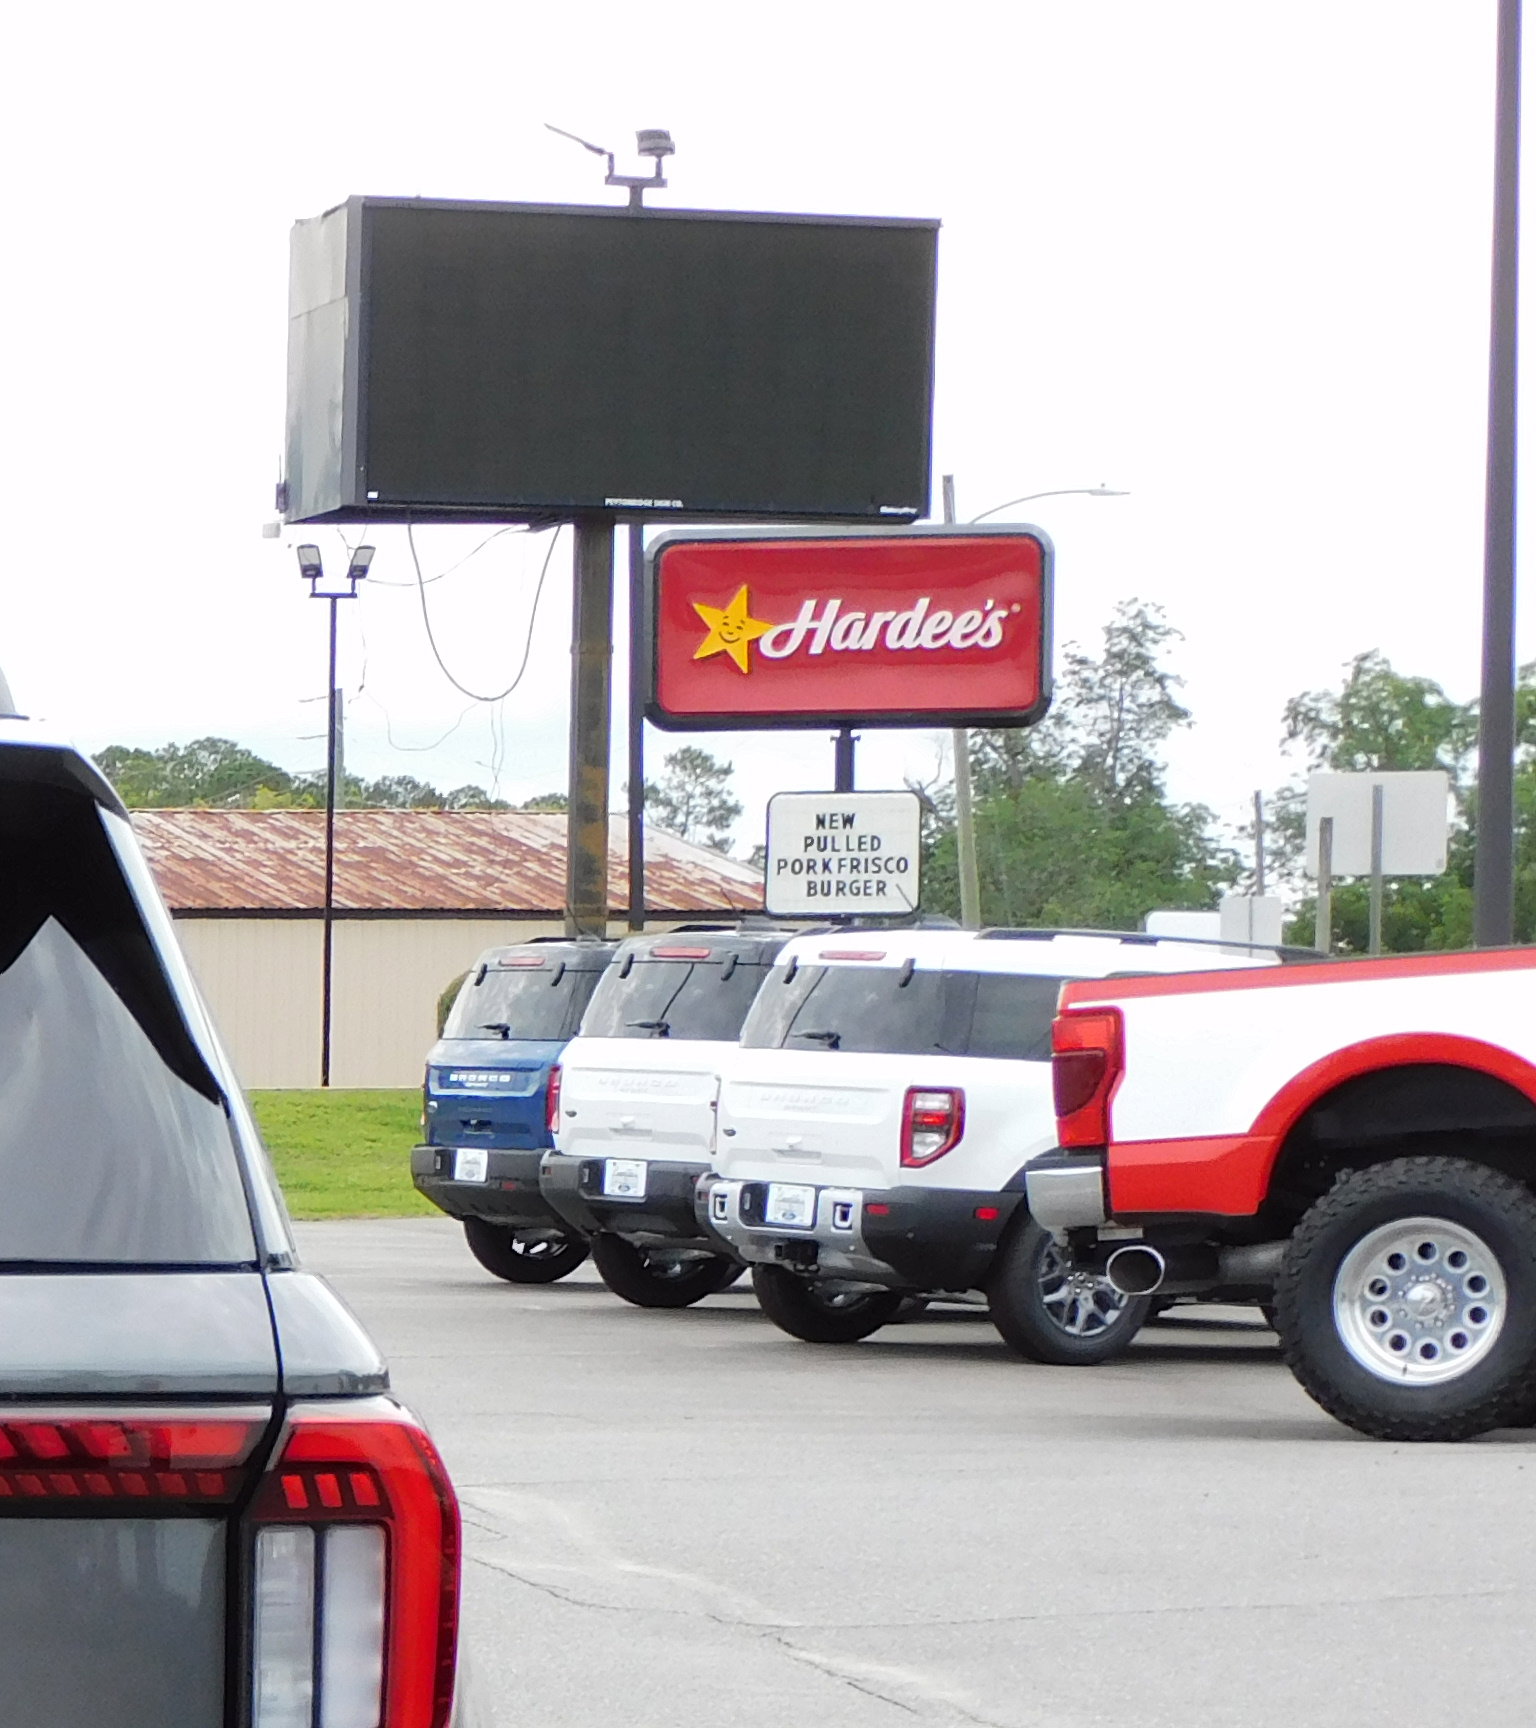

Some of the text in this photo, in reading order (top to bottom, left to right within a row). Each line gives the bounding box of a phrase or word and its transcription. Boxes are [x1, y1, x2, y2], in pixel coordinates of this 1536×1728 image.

[758, 597, 1008, 659] Hardee's
[815, 813, 856, 831] NEW
[803, 835, 882, 853] PULLED
[776, 857, 909, 876] PORK FRISCO
[806, 879, 888, 898] BURGER
